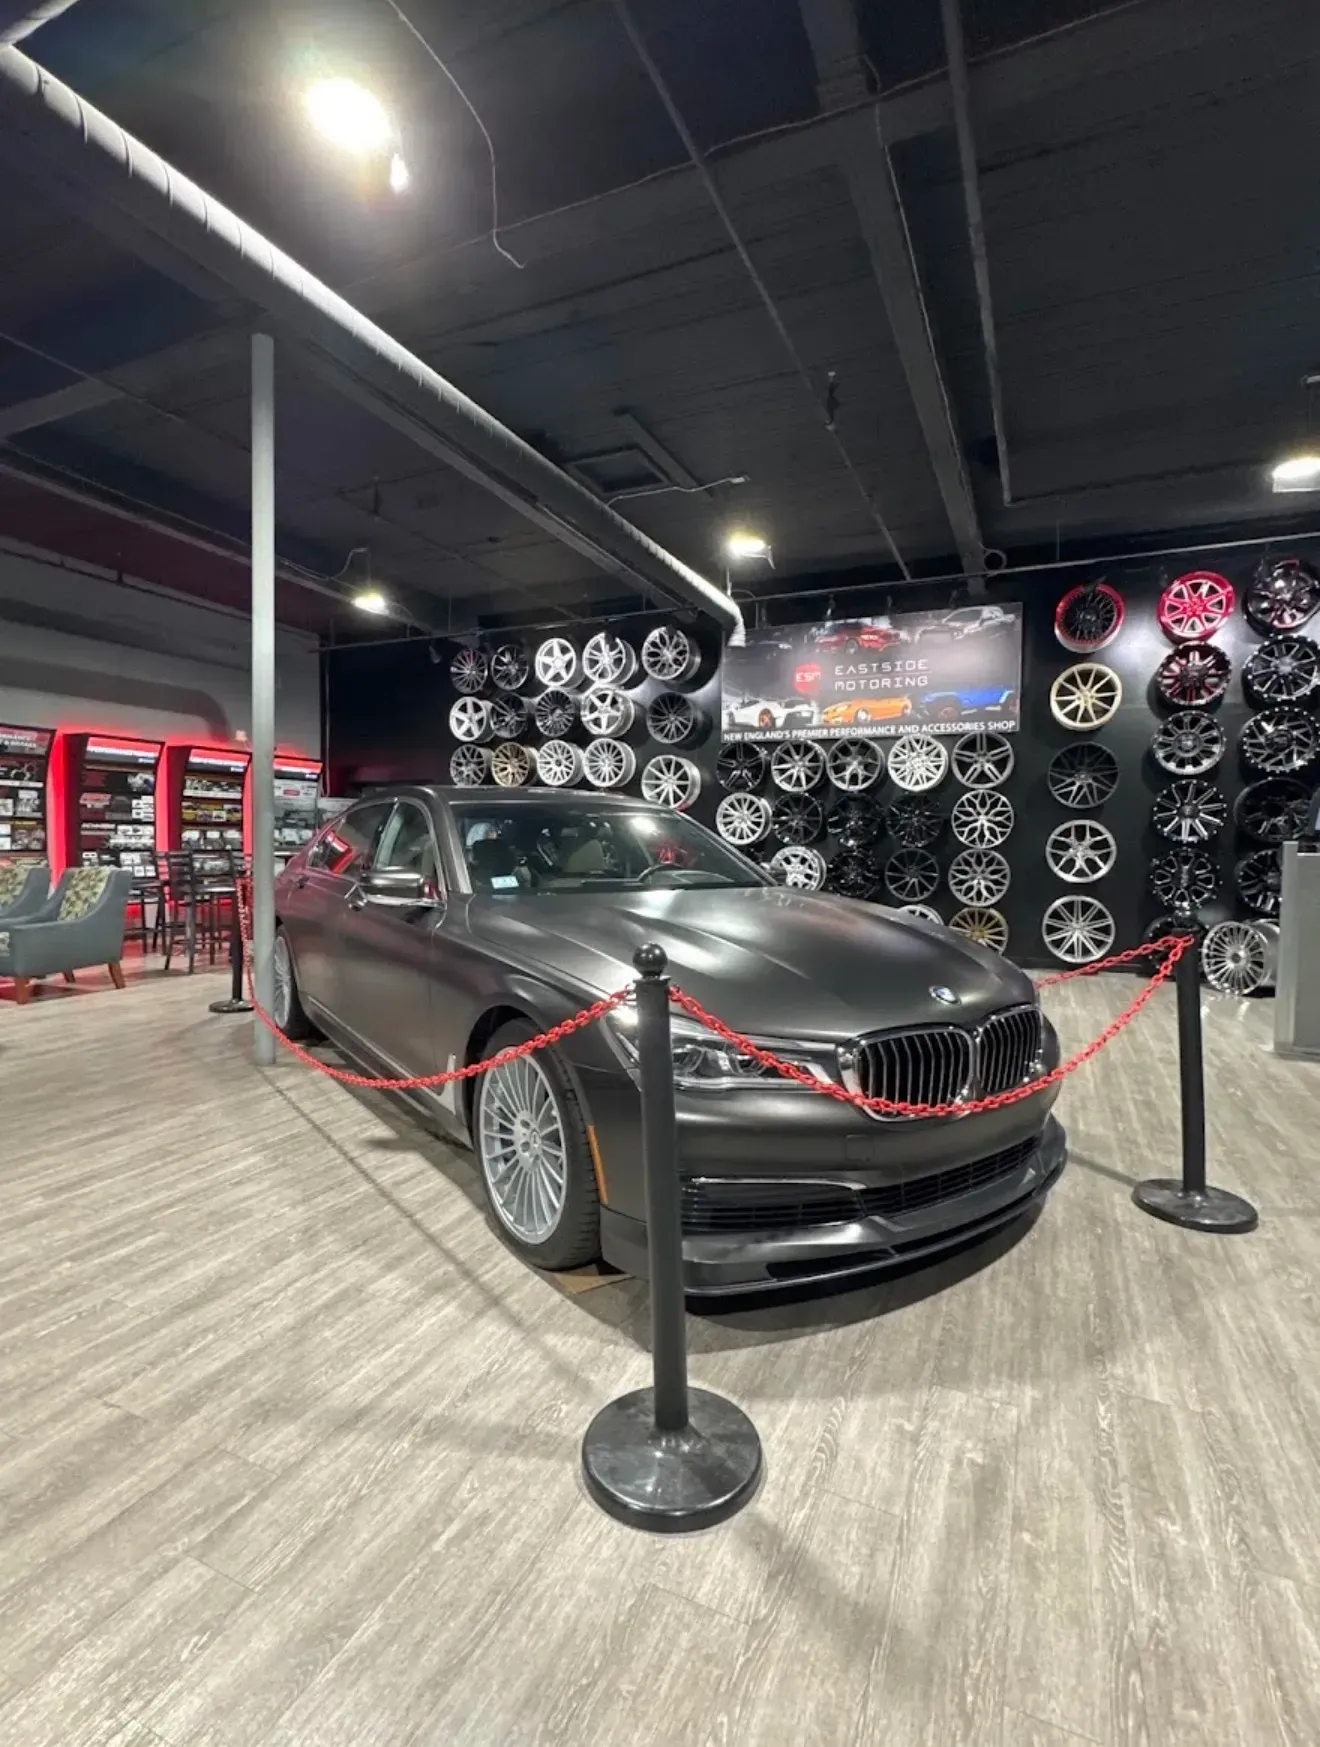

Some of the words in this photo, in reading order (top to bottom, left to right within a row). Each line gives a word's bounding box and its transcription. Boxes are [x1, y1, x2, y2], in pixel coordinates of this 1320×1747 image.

[834, 659, 929, 676] EASTSIDE
[834, 675, 929, 691] MOTORING
[723, 733, 741, 741] NEW
[744, 731, 790, 740] ENGLAND'S
[791, 728, 828, 738] PREMIER
[830, 725, 896, 736] PERFORMANCE
[898, 724, 919, 734] AND
[921, 722, 985, 732] ACCESSORIES
[987, 721, 1016, 731] SHOP
